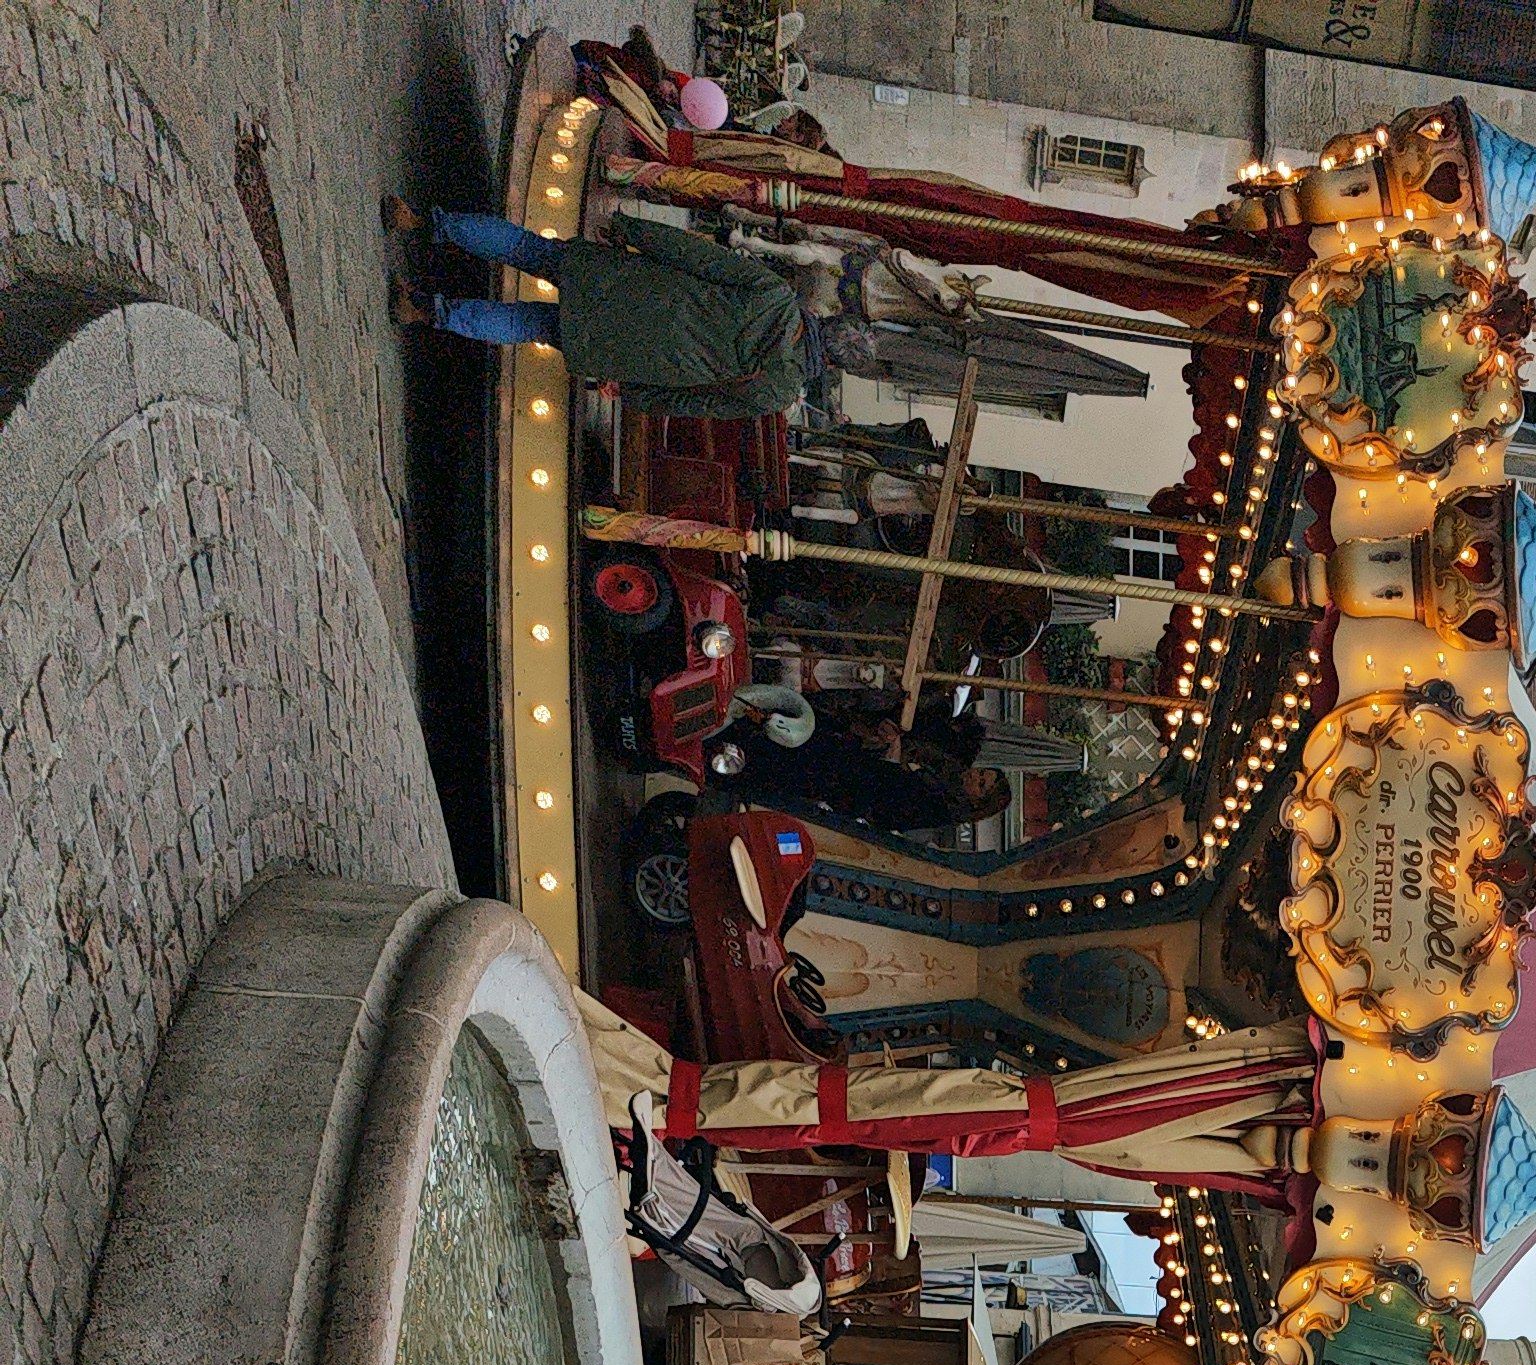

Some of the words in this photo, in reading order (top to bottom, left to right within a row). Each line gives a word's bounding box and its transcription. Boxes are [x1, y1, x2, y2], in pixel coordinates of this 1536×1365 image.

[1371, 823, 1395, 942] PERRIER
[1400, 838, 1423, 900] 1900
[1424, 760, 1465, 976] Carrousel
